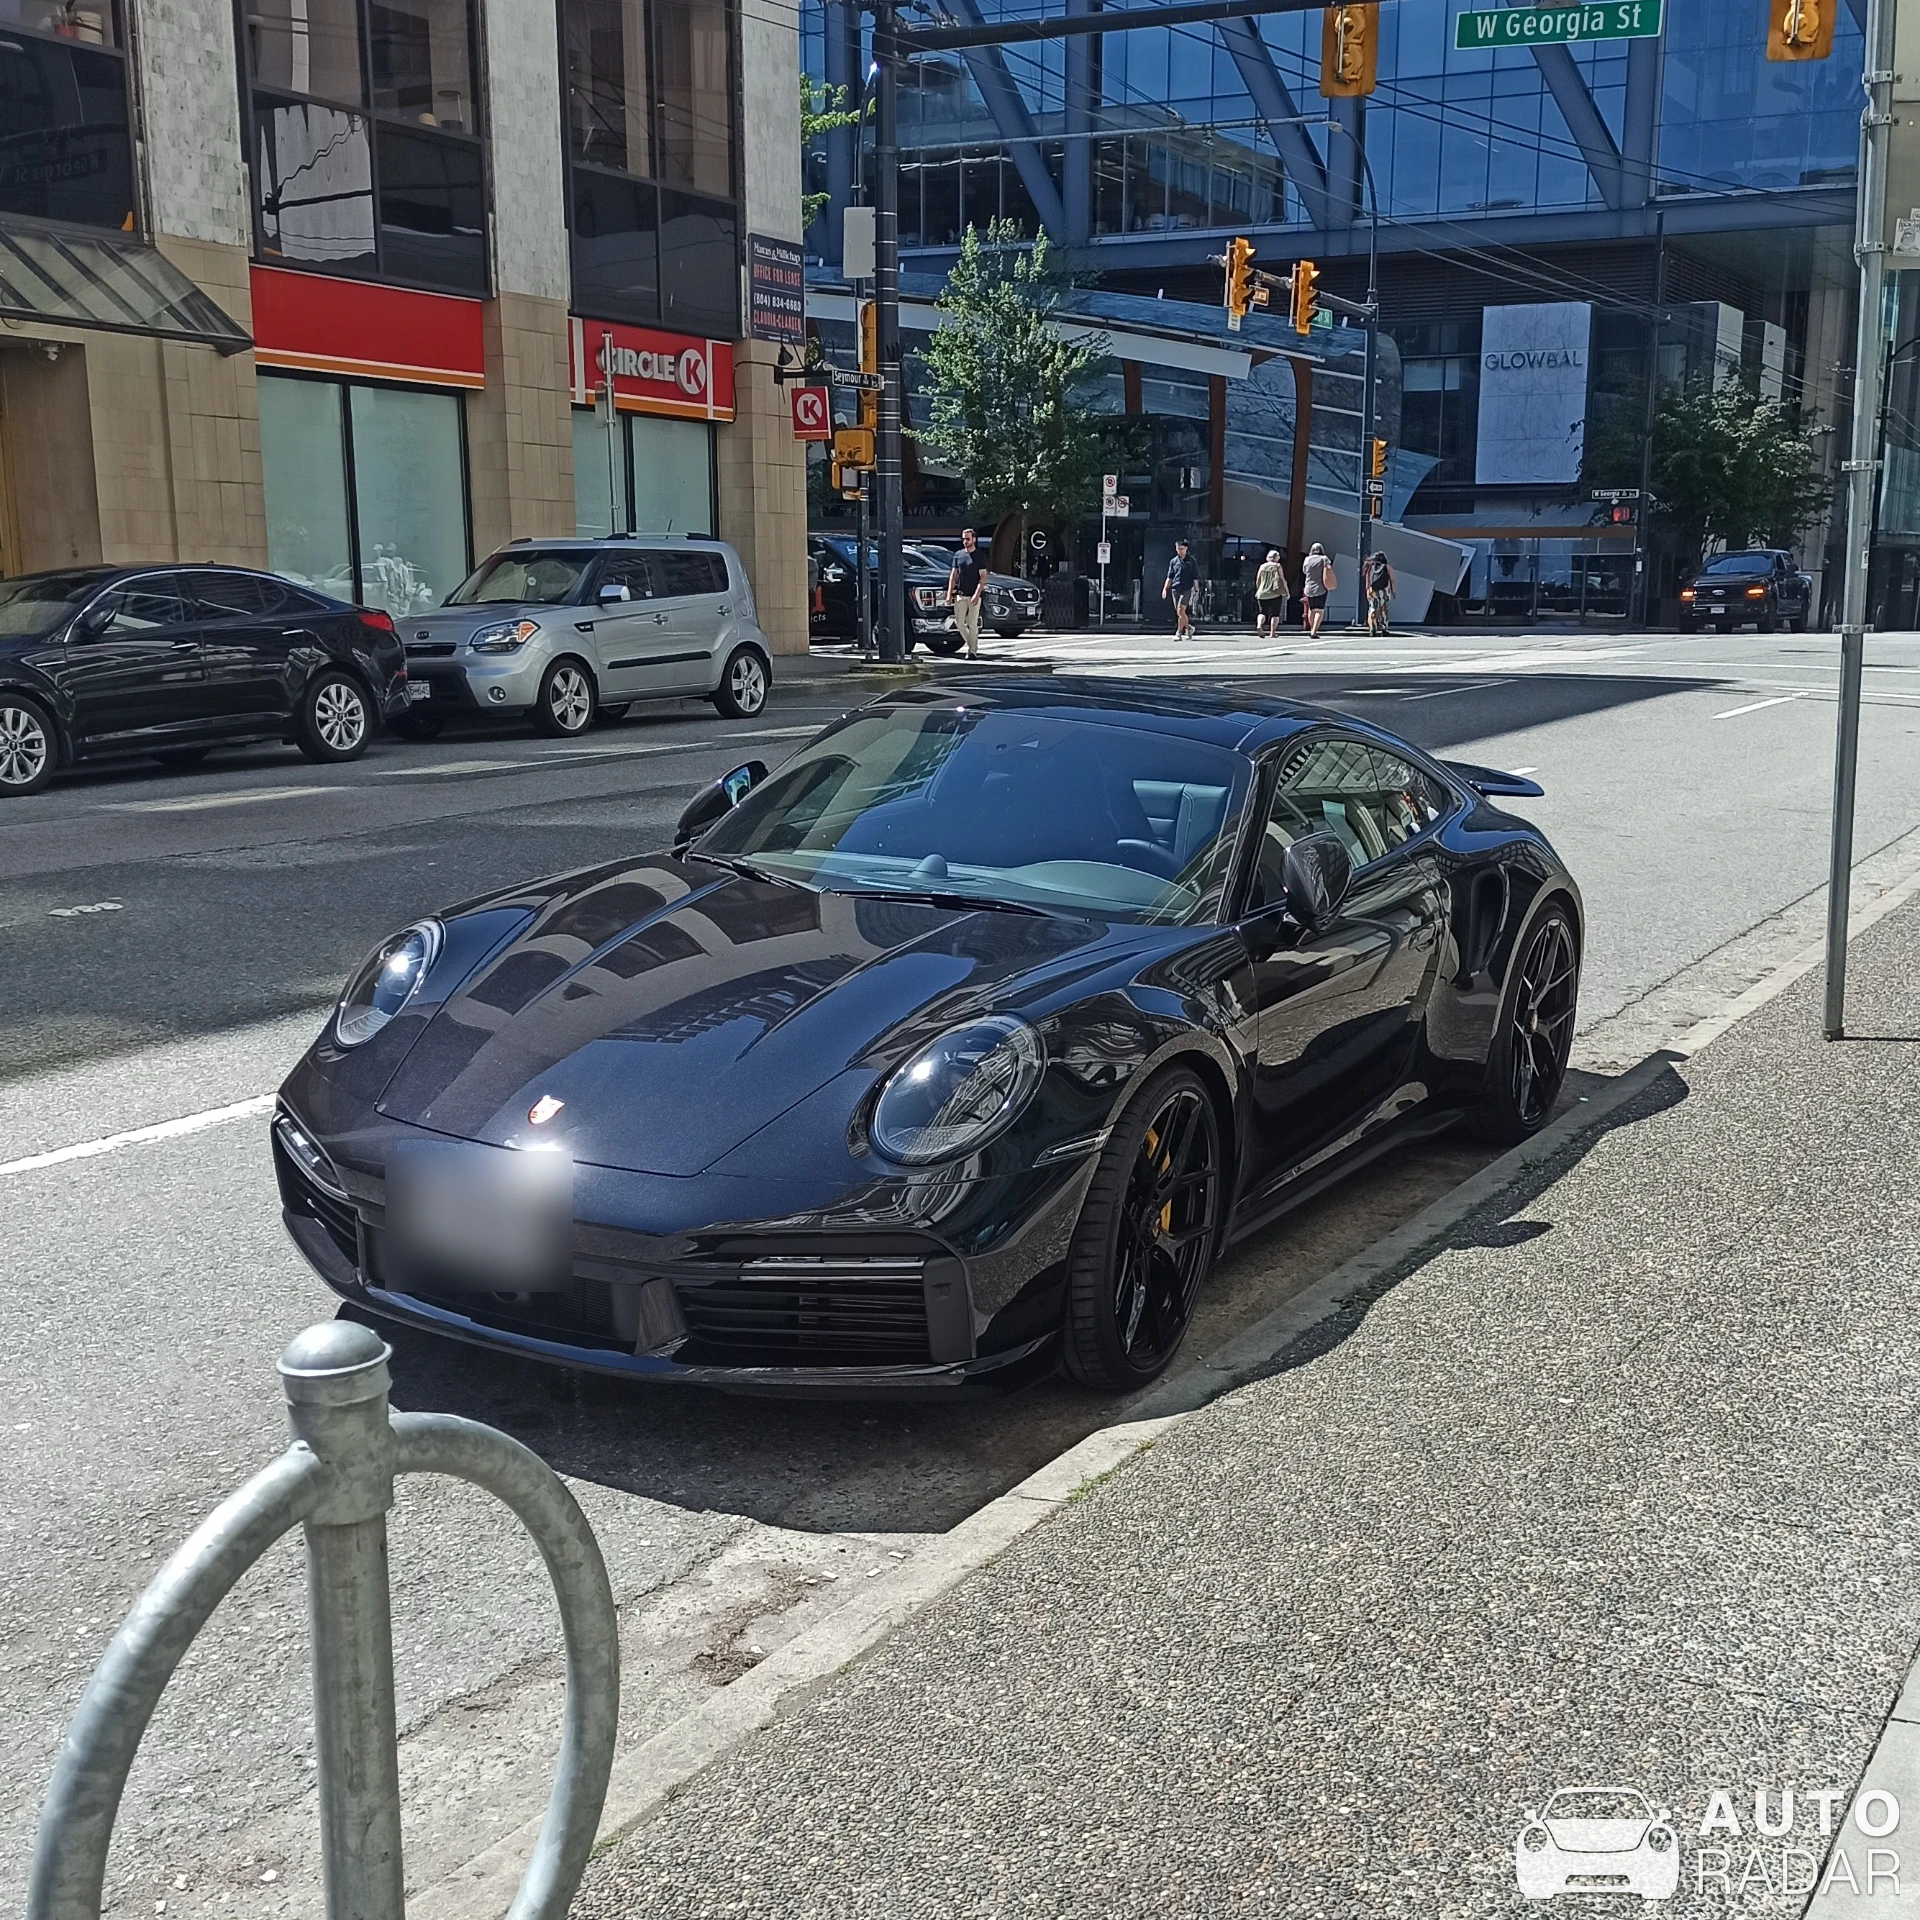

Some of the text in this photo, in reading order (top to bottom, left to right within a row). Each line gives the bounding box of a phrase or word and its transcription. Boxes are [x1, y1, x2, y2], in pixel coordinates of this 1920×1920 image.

[1476, 4, 1642, 40] W Georgia St
[753, 263, 801, 287] OFFICE FOR LEASE
[597, 347, 704, 391] CIRCLE K
[1484, 350, 1584, 371] GLOWBAL
[834, 370, 861, 384] Seymour
[801, 398, 821, 424] K
[1030, 531, 1048, 550] G
